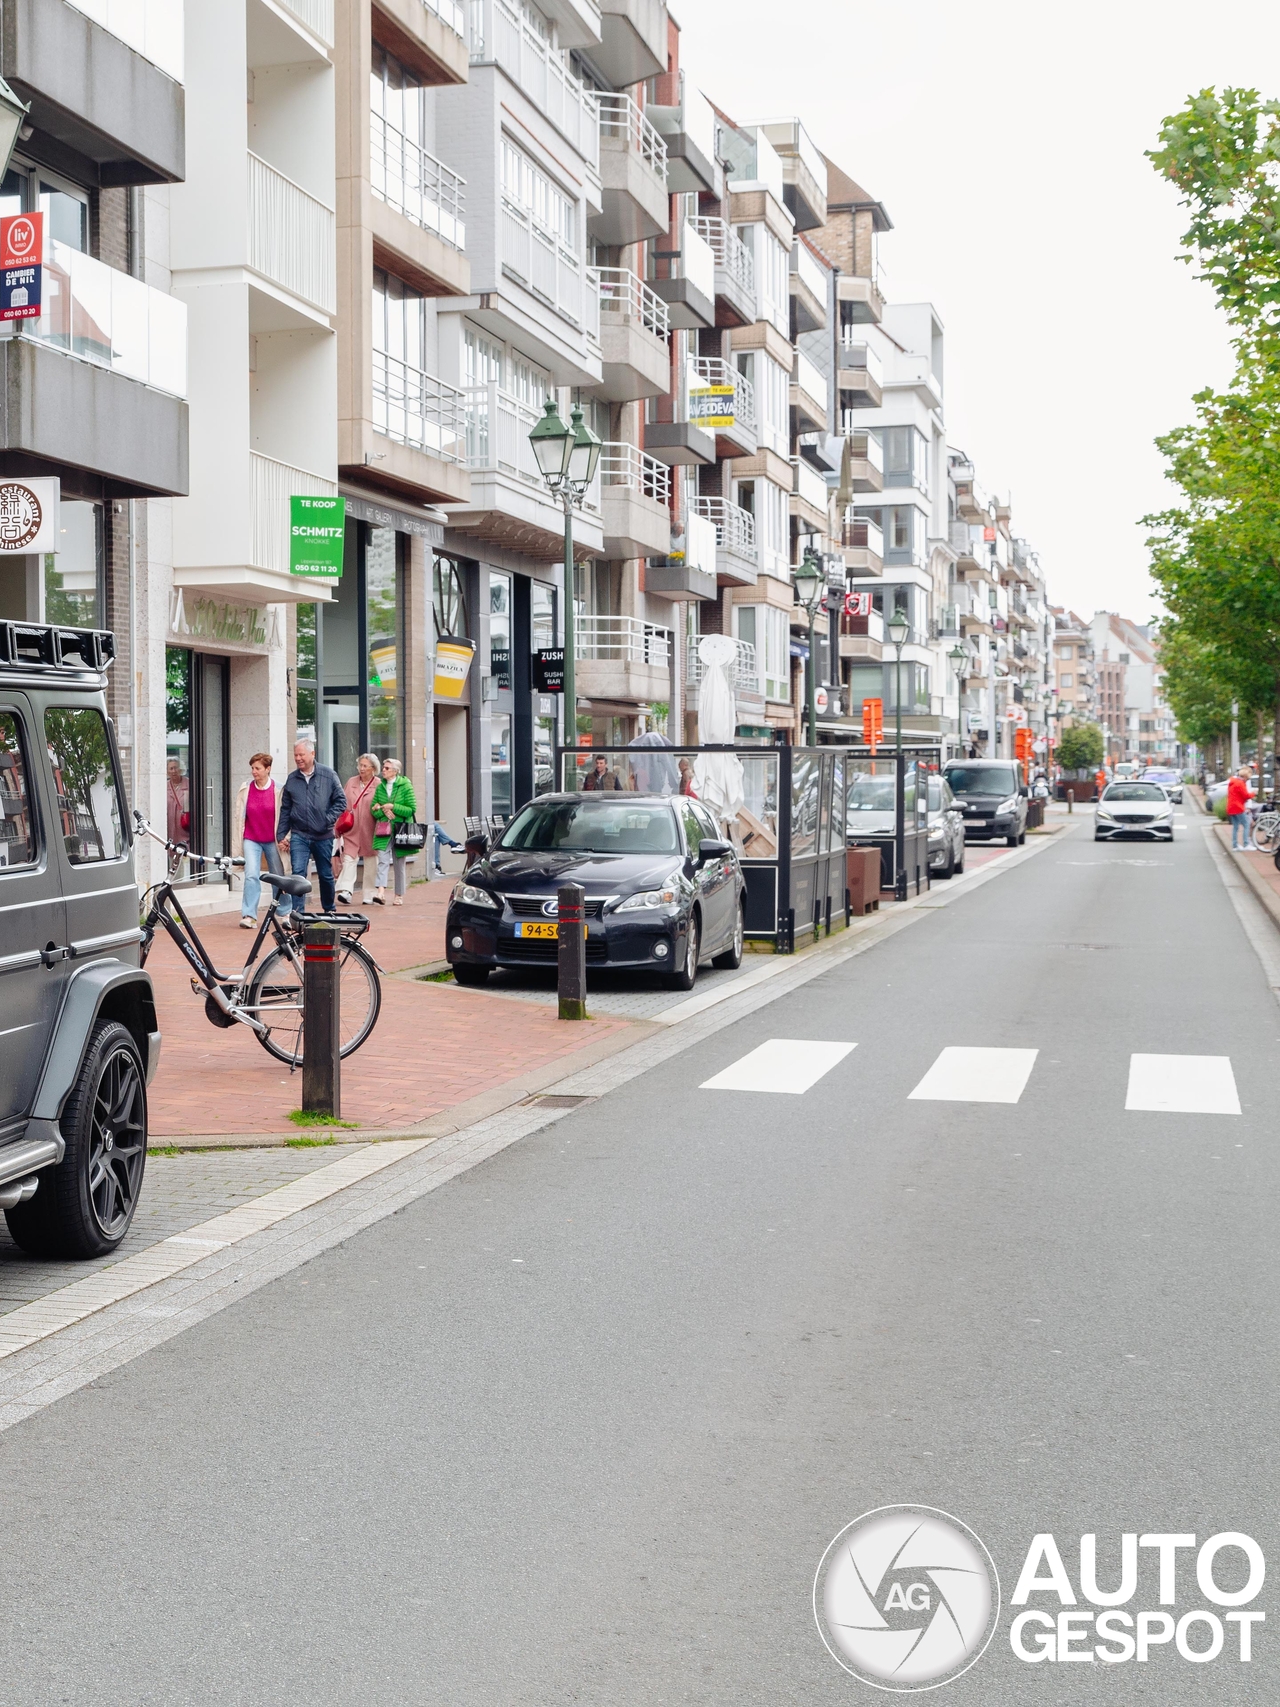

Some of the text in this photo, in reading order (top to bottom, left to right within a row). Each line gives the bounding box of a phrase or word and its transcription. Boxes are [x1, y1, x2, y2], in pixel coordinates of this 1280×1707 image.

[6, 268, 35, 279] CAMBIER
[6, 276, 34, 286] DE NIL
[292, 526, 343, 538] SCHMITZ
[541, 652, 564, 660] ZUSH
[526, 925, 558, 936] 94-S
[183, 942, 208, 978] KOGA
